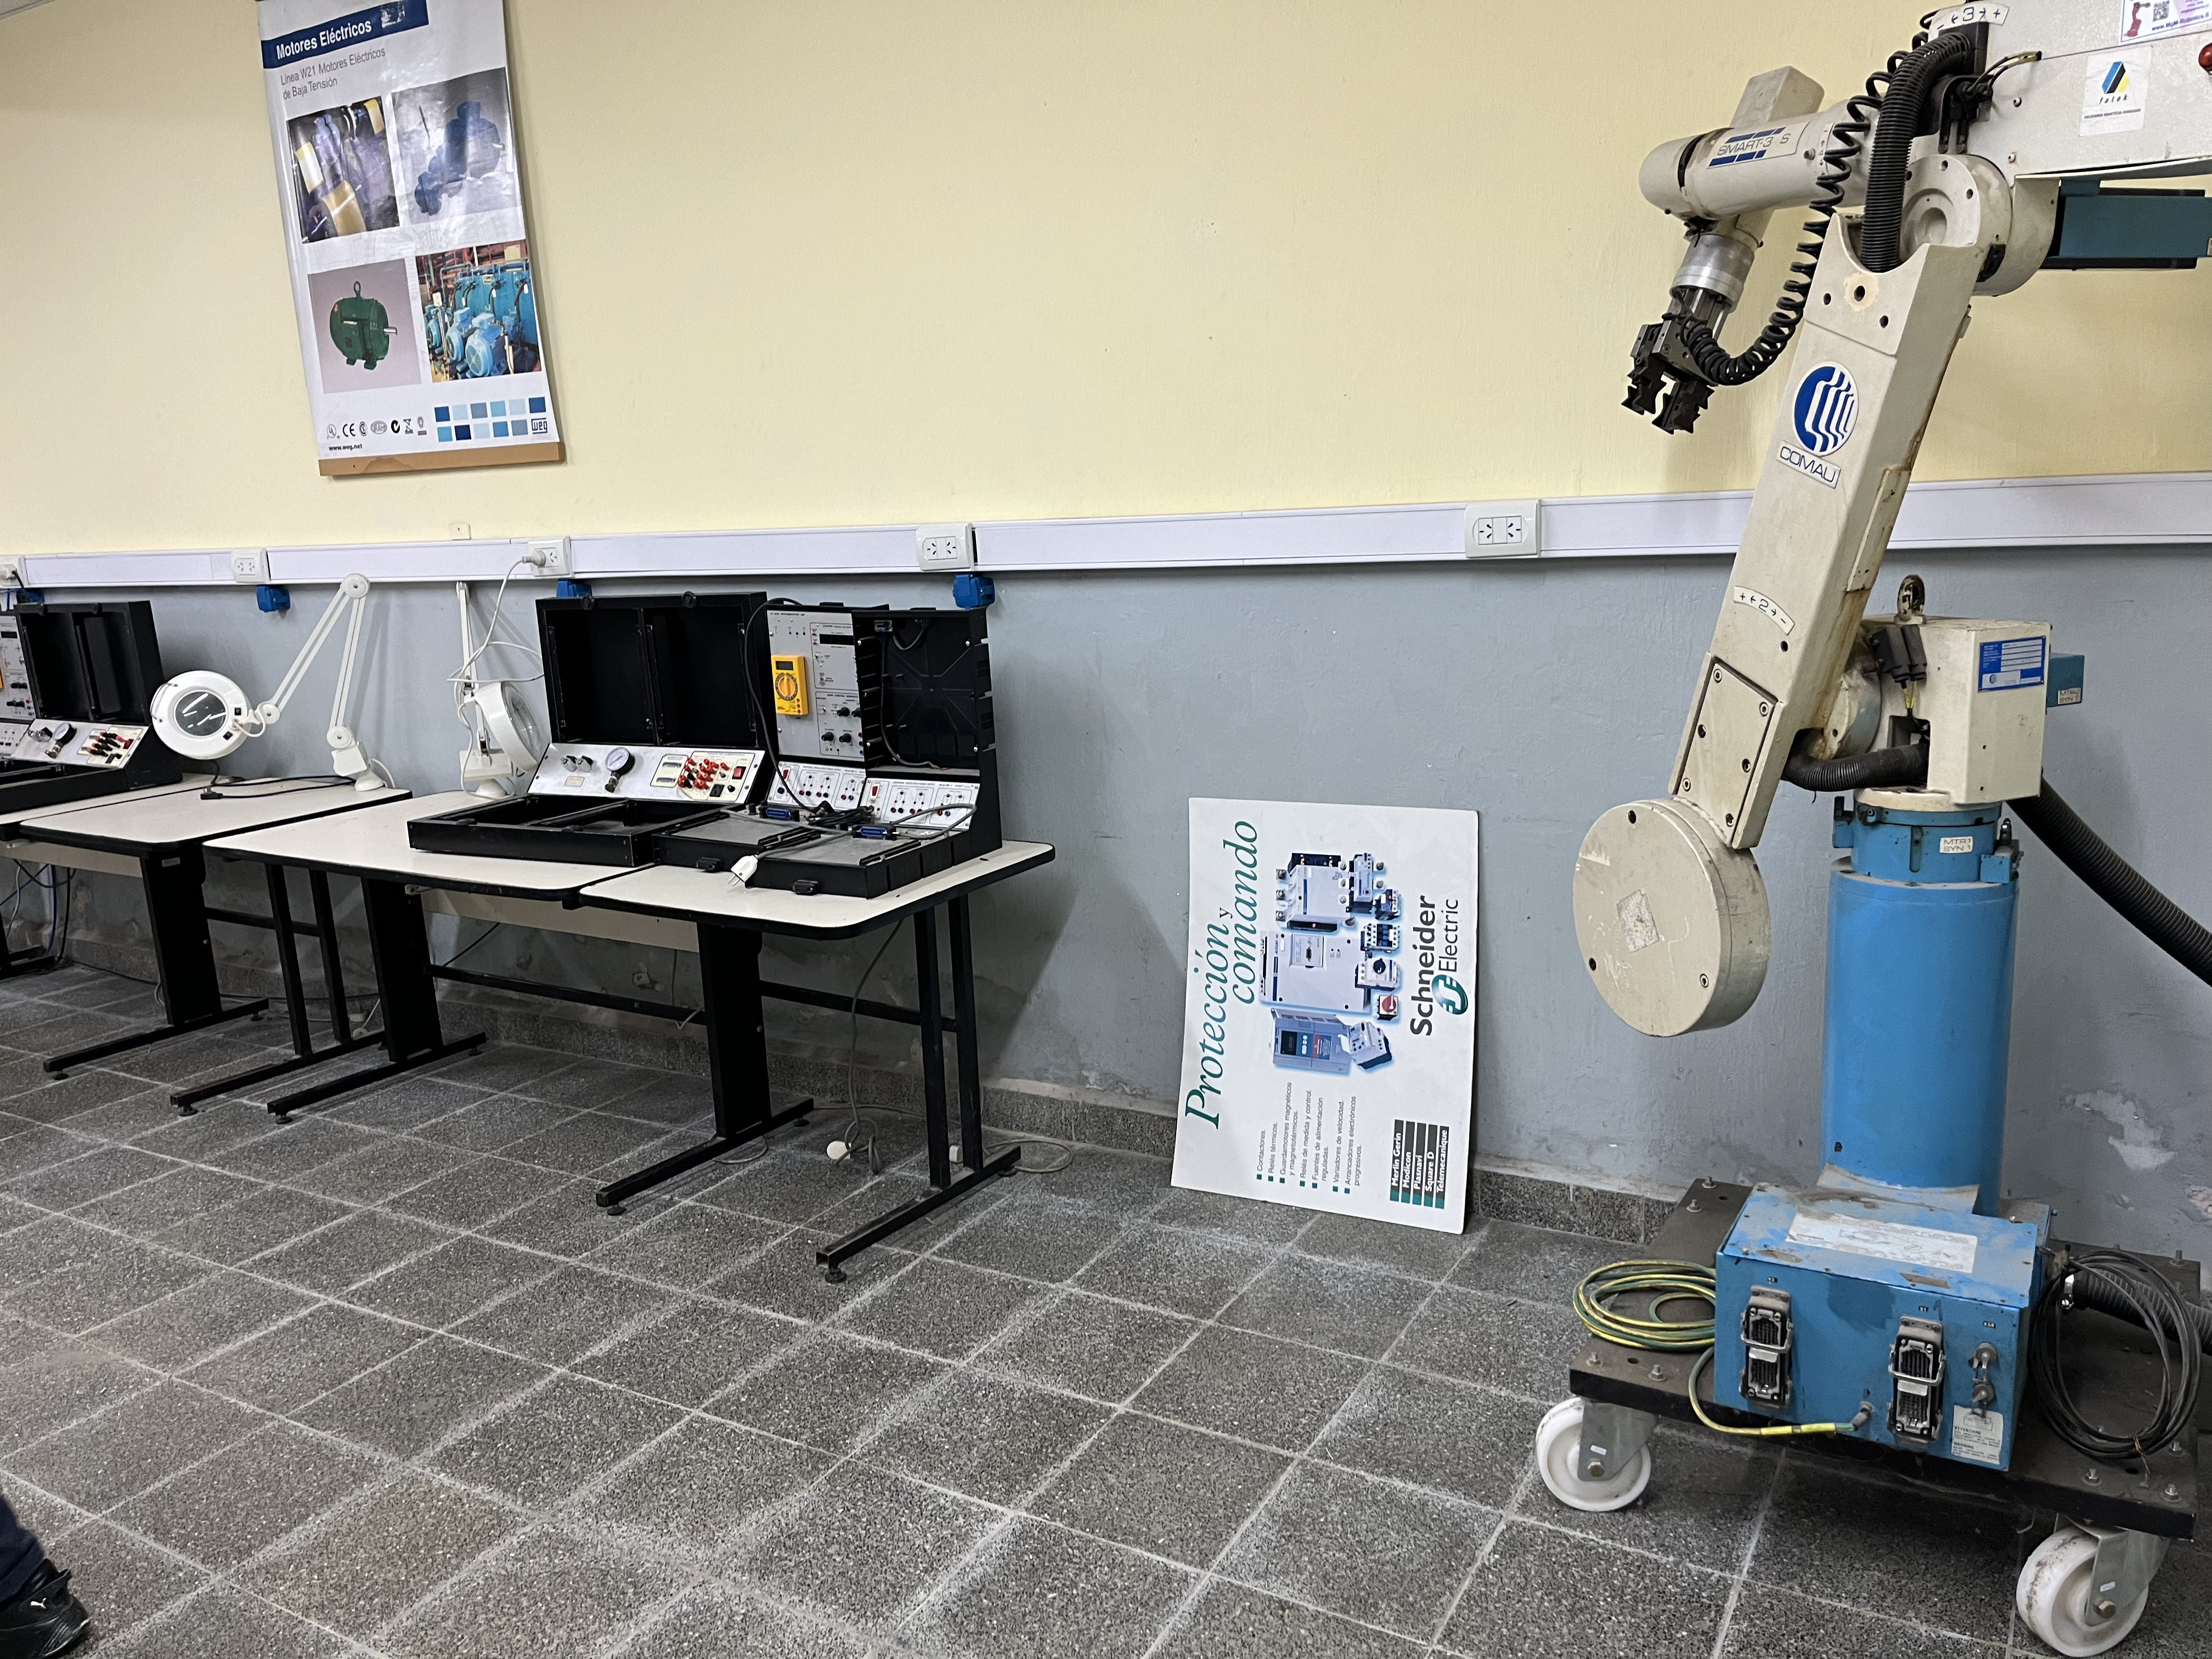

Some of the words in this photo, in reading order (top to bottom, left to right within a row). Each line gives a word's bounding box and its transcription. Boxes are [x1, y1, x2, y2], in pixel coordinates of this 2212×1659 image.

[276, 38, 318, 59] Motores
[319, 20, 372, 47] Eléctricos
[300, 65, 316, 79] W21
[318, 59, 348, 75] Motores
[349, 48, 386, 66] Eléctricos
[283, 89, 291, 100] de
[292, 84, 308, 97] Baja
[309, 77, 338, 92] Tensión
[1718, 137, 1774, 156] SMART-3
[1780, 133, 1791, 144] S
[1780, 446, 1836, 483] COMAU
[1758, 599, 1769, 613] 2
[1223, 821, 1258, 1005] comando
[1438, 899, 1458, 973] Electric
[1410, 895, 1436, 1036] Schneider
[1185, 924, 1229, 1130] Protección
[1220, 907, 1233, 919] y
[1257, 1129, 1266, 1171] Contactores.
[1280, 1122, 1289, 1175] Guardamotores
[1302, 1148, 1308, 1157] de
[1316, 1142, 1321, 1151] de
[1336, 1136, 1342, 1144] de
[1393, 1132, 1402, 1156] Gerin
[1333, 1146, 1341, 1183] Variadores
[1345, 1139, 1354, 1185] Arrancadores
[1391, 1159, 1400, 1186] Merlin
[1402, 1152, 1412, 1188] Modicon
[1414, 1155, 1423, 1190] Plasnavi
[1425, 1161, 1434, 1192] Square
[1436, 1130, 1448, 1193] Telemecanique
